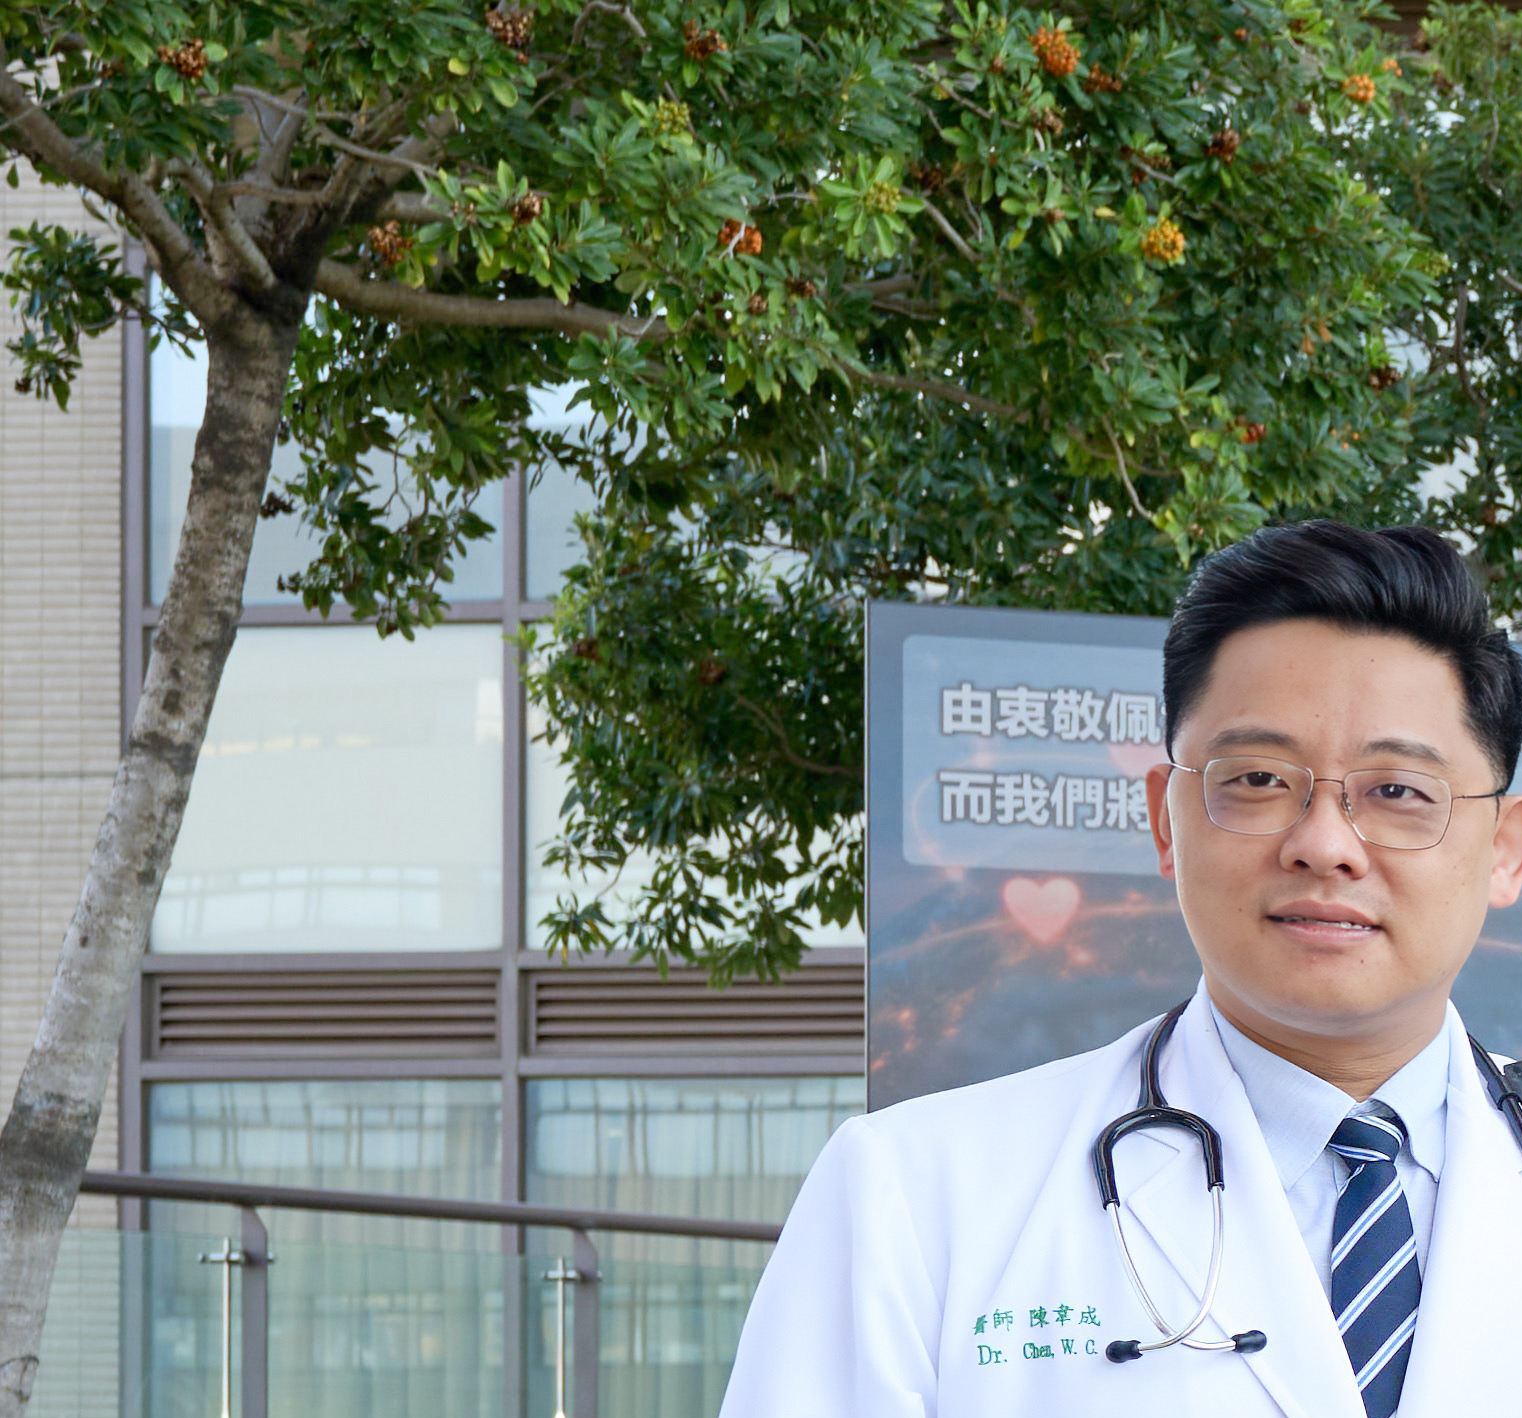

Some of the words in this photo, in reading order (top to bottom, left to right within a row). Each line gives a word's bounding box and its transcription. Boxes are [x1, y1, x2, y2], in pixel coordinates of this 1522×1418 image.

[942, 682, 1166, 744] 由衷敬佩
[977, 1345, 1008, 1365] Dr.
[1061, 1338, 1077, 1355] W.
